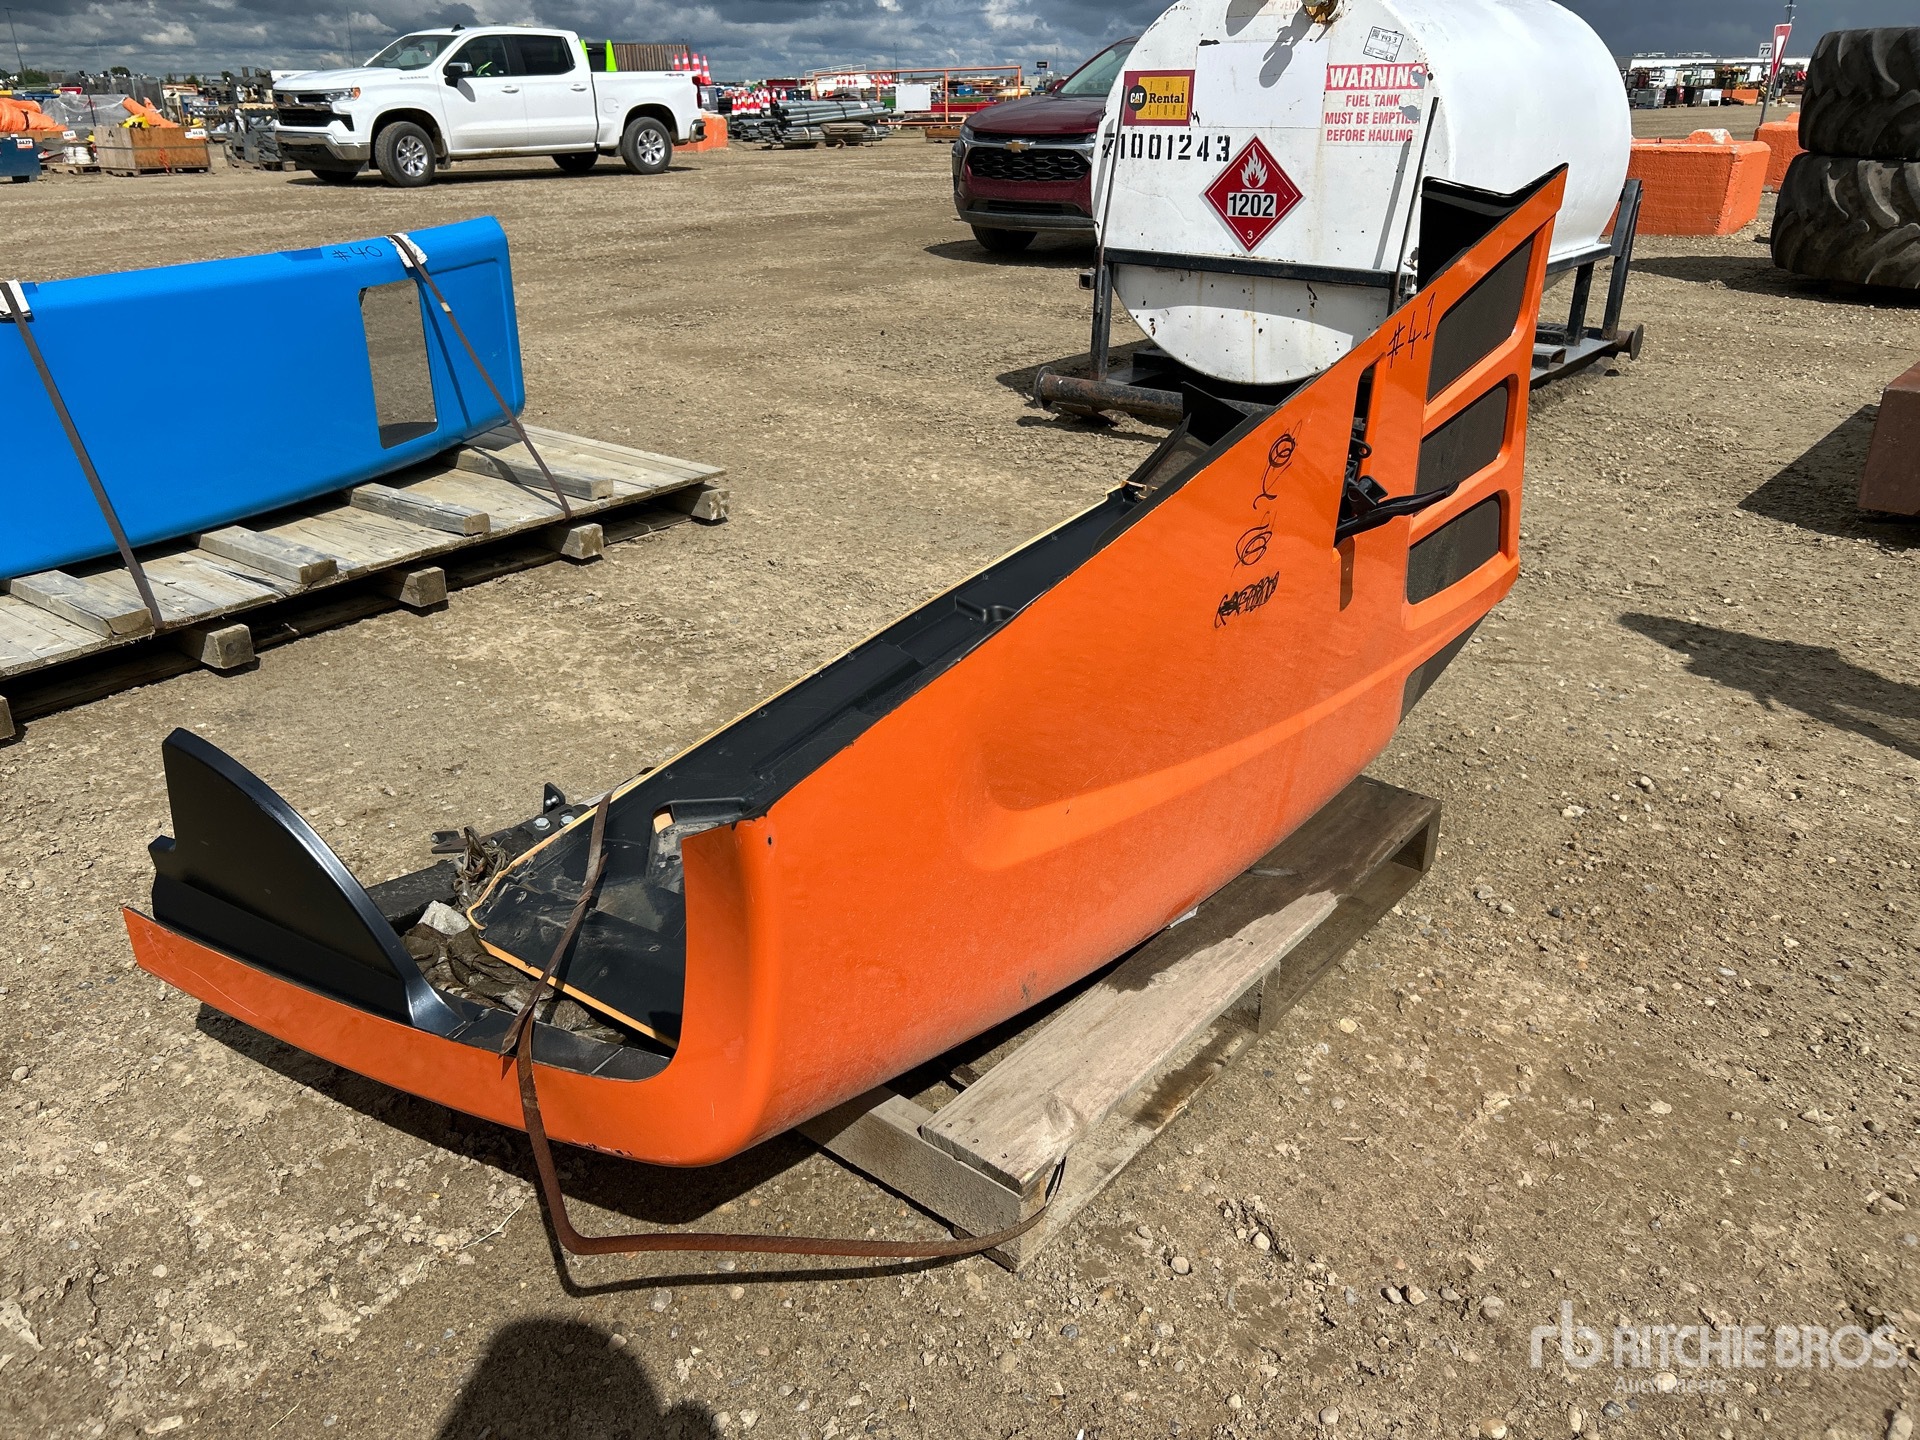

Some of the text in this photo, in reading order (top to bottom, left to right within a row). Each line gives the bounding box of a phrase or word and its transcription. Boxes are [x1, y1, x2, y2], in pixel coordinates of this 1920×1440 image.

[1760, 47, 1771, 55] 77
[1130, 92, 1185, 104] CAT Rental
[1345, 94, 1401, 107] FUEL TANK
[1325, 111, 1418, 125] MUST BE EMPTI
[1326, 128, 1413, 142] BEFORE HAULING
[1228, 193, 1275, 217] 1202
[1247, 230, 1254, 240] 3
[332, 245, 383, 262] #40
[1387, 291, 1437, 369] #41
